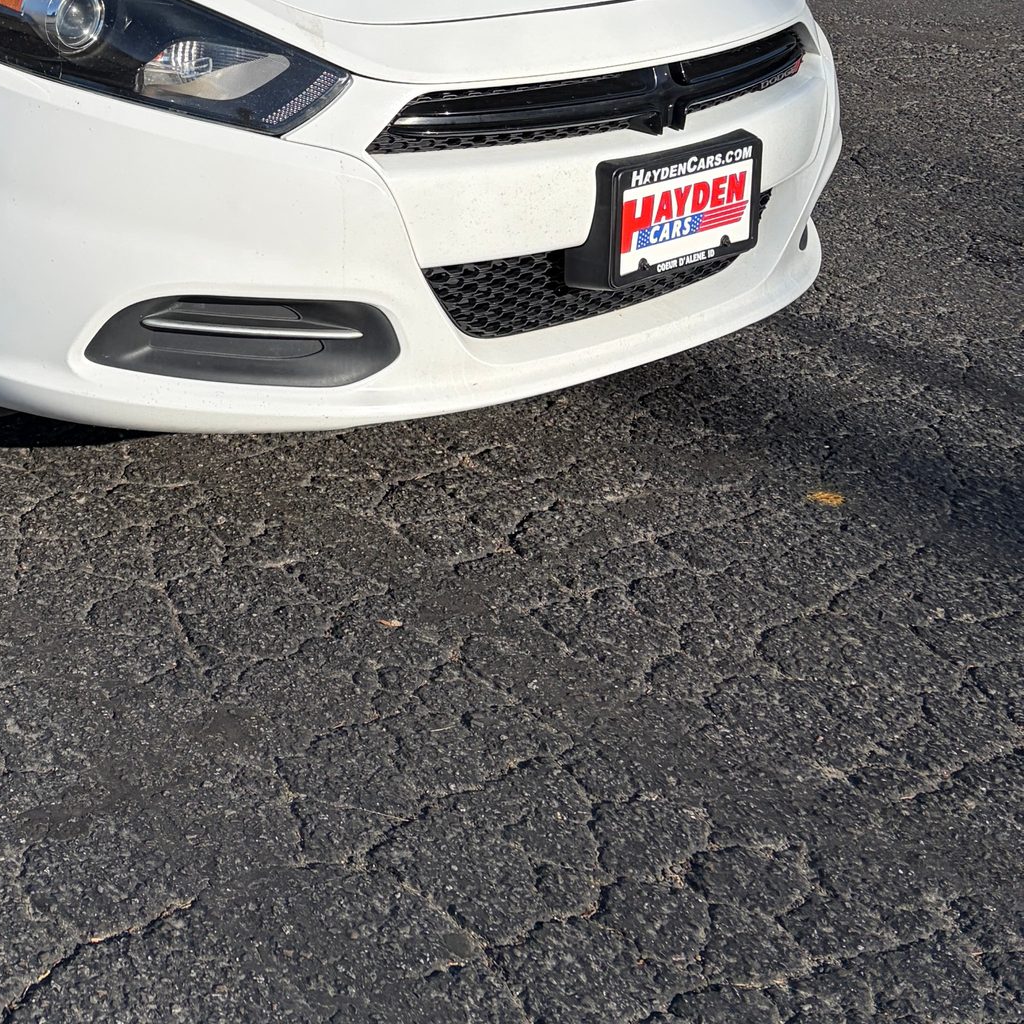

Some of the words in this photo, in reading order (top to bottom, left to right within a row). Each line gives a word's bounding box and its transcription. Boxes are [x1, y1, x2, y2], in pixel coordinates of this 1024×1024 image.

[620, 171, 747, 254] HAYDEN
[648, 216, 692, 245] CARS
[656, 259, 678, 273] COEUR
[707, 249, 715, 259] ID
